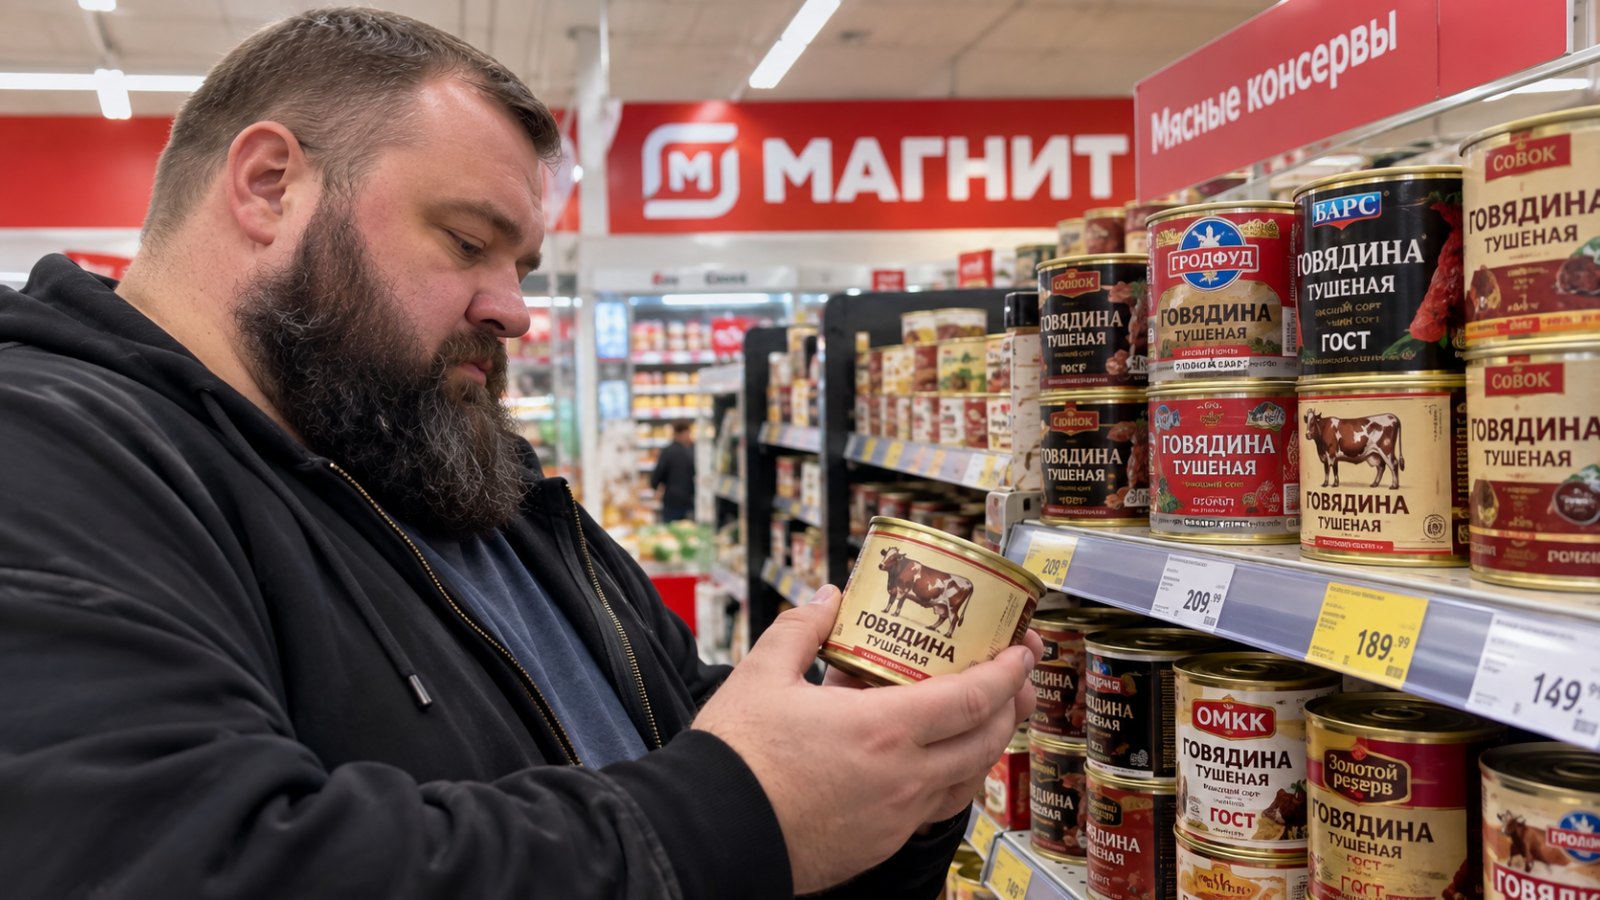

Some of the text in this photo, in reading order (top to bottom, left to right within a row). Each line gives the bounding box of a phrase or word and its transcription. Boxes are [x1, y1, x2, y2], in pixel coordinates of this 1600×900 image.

[1150, 9, 1397, 155] Мясные консервы
[762, 134, 1129, 203] МАГНИТ
[1315, 195, 1376, 223] БАРС
[1484, 224, 1578, 254] ТУШЕНАЯ
[1171, 250, 1254, 272] ГРОДФУД
[1297, 238, 1425, 278] ГОВЯДИНА
[1306, 275, 1396, 301] ТУШЕНАЯ
[1161, 303, 1272, 328] ГОВЯДИНА
[1175, 327, 1247, 342] ТУШЕНАЯ
[1321, 330, 1371, 353] ГОСТ
[1162, 434, 1276, 457] ГОВЯДИНА
[1484, 449, 1572, 468] ТУШЕНАЯ
[1048, 468, 1105, 482] ТУШЕНАЯ
[1173, 459, 1257, 476] ТУШЕНАЯ
[1306, 490, 1410, 516] ГОВЯДИНА
[1317, 515, 1382, 533] ТУШЕНАЯ
[855, 610, 956, 664] ГОВЯДИНА
[865, 633, 930, 669] ТУШЕНАЯ
[1197, 706, 1267, 732] ОМКК
[1183, 737, 1293, 770] ГОВЯДИНА
[1195, 763, 1270, 787] ТУШЕНАЯ
[1210, 807, 1256, 829] ГОСТ
[1312, 798, 1435, 844] ГОВЯДИНА
[1328, 831, 1402, 860] ТУШЕНАЯ
